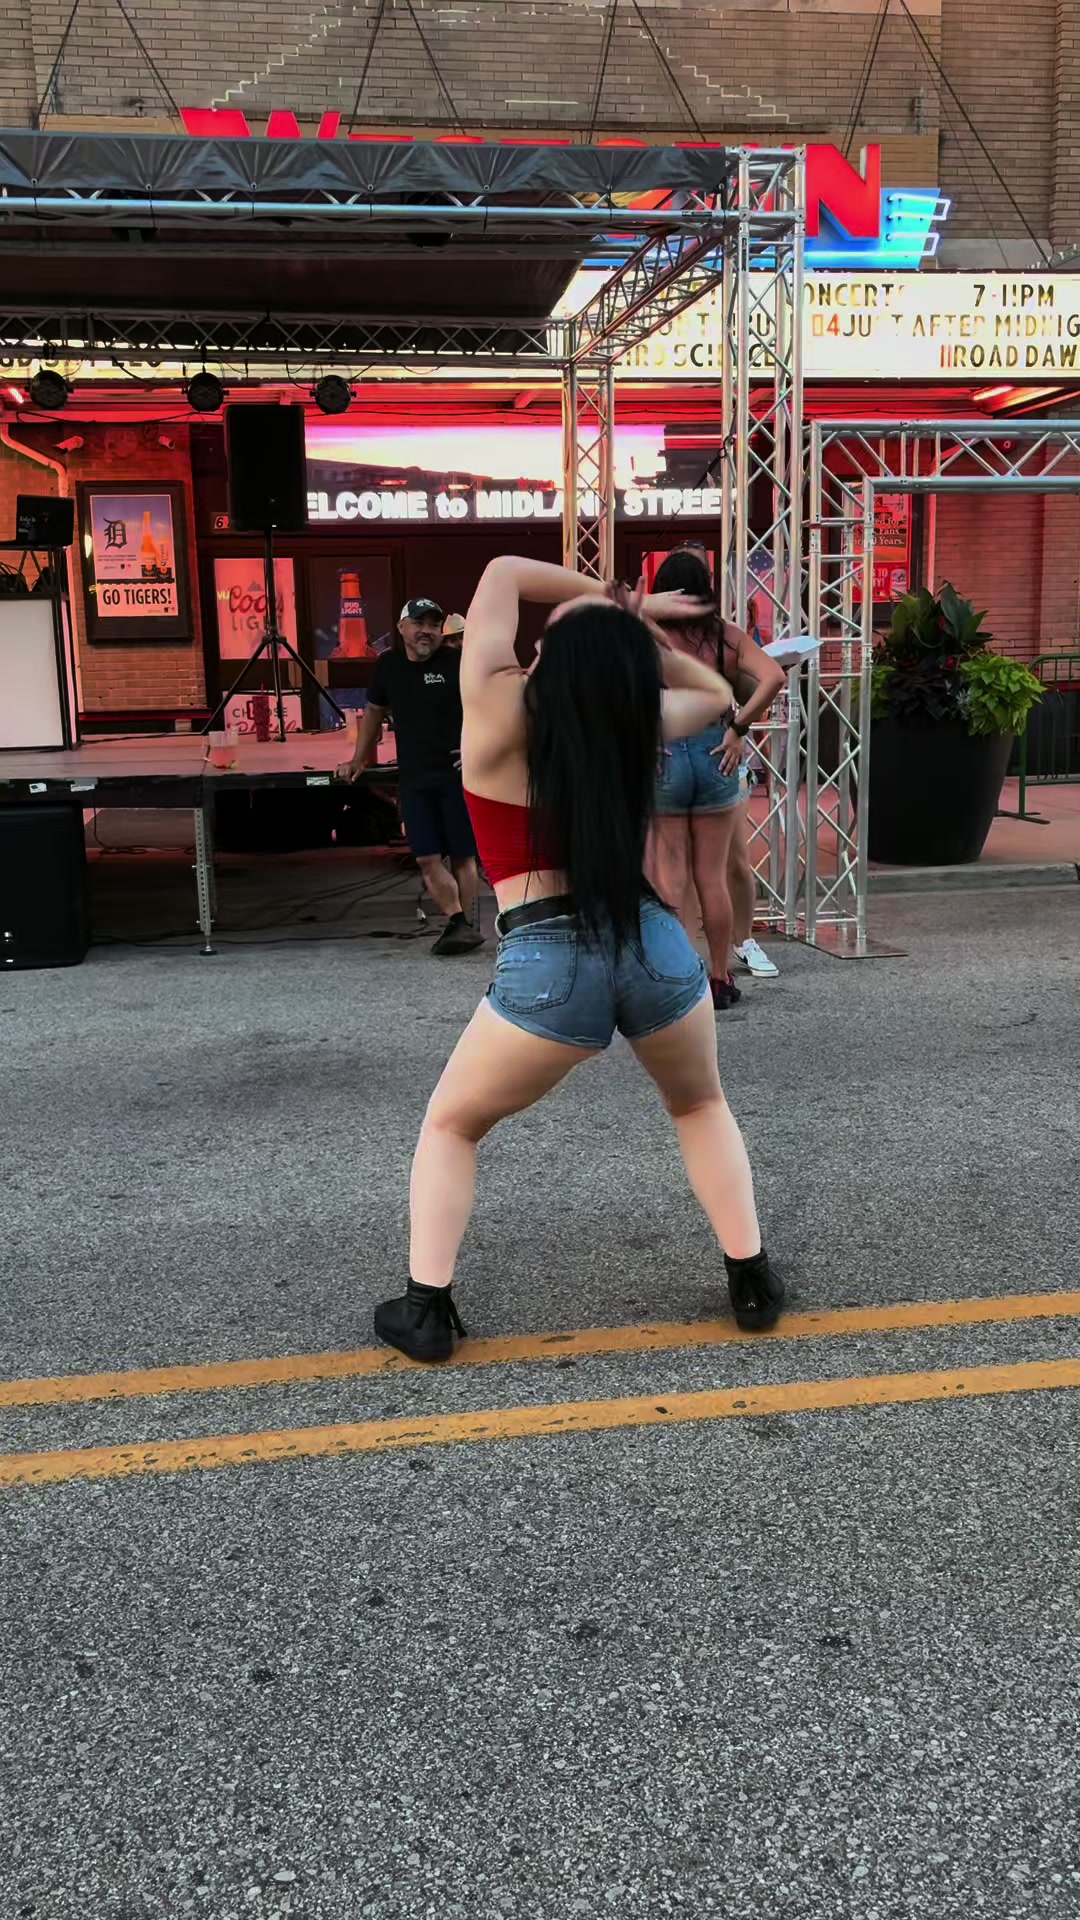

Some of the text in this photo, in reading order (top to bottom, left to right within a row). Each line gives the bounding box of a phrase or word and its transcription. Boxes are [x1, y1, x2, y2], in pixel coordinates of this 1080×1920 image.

[306, 491, 428, 519] ELCOME
[435, 492, 468, 519] to
[623, 488, 738, 517] STREE
[103, 588, 172, 605] GO TIGERS!
